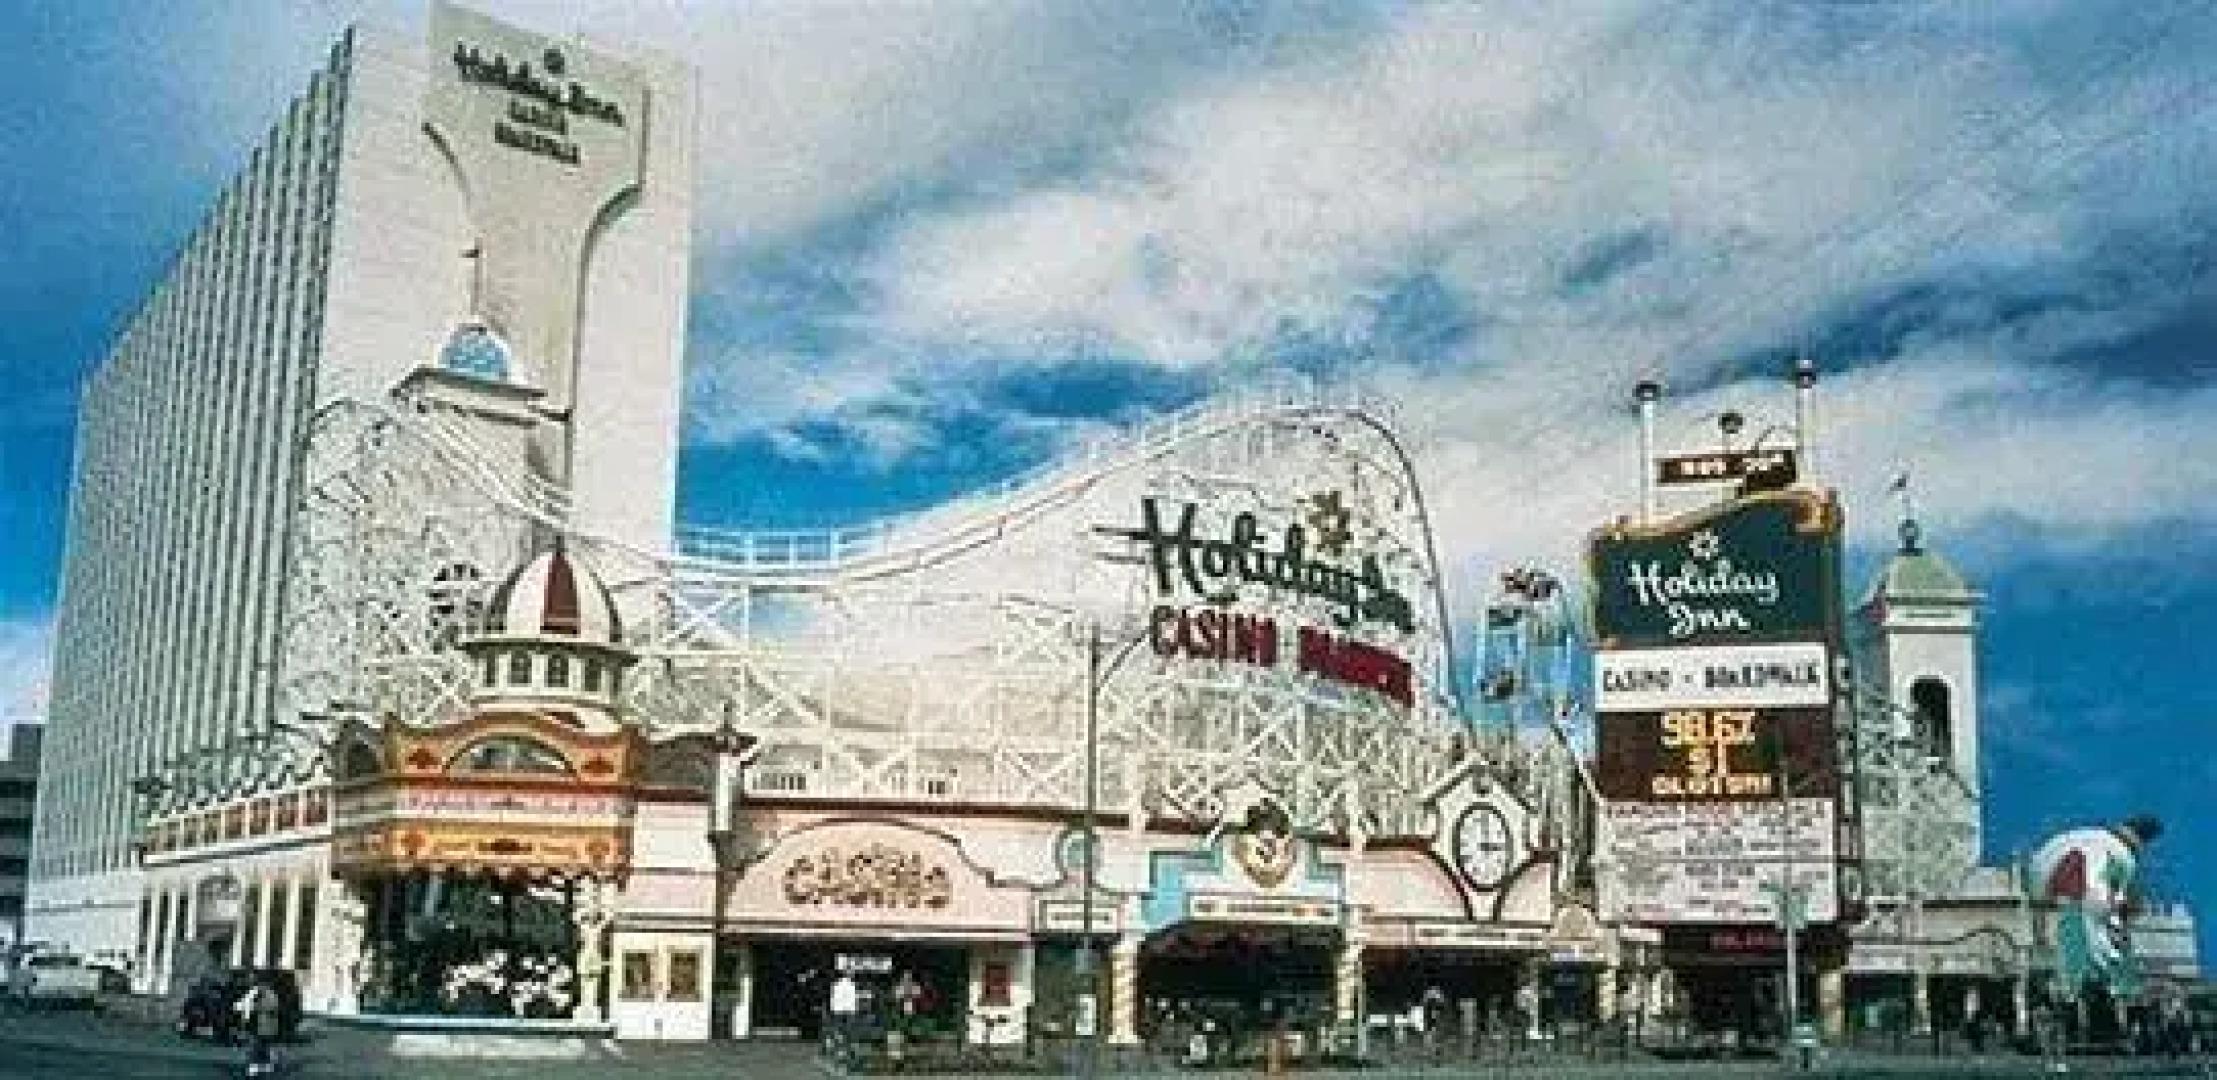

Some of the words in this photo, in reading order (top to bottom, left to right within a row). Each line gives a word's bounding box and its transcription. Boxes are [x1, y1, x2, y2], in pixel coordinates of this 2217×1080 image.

[1093, 497, 1362, 628] Holiday
[1628, 558, 1781, 605] Holiday
[1668, 601, 1753, 635] Inn
[782, 843, 954, 910] CASINO
